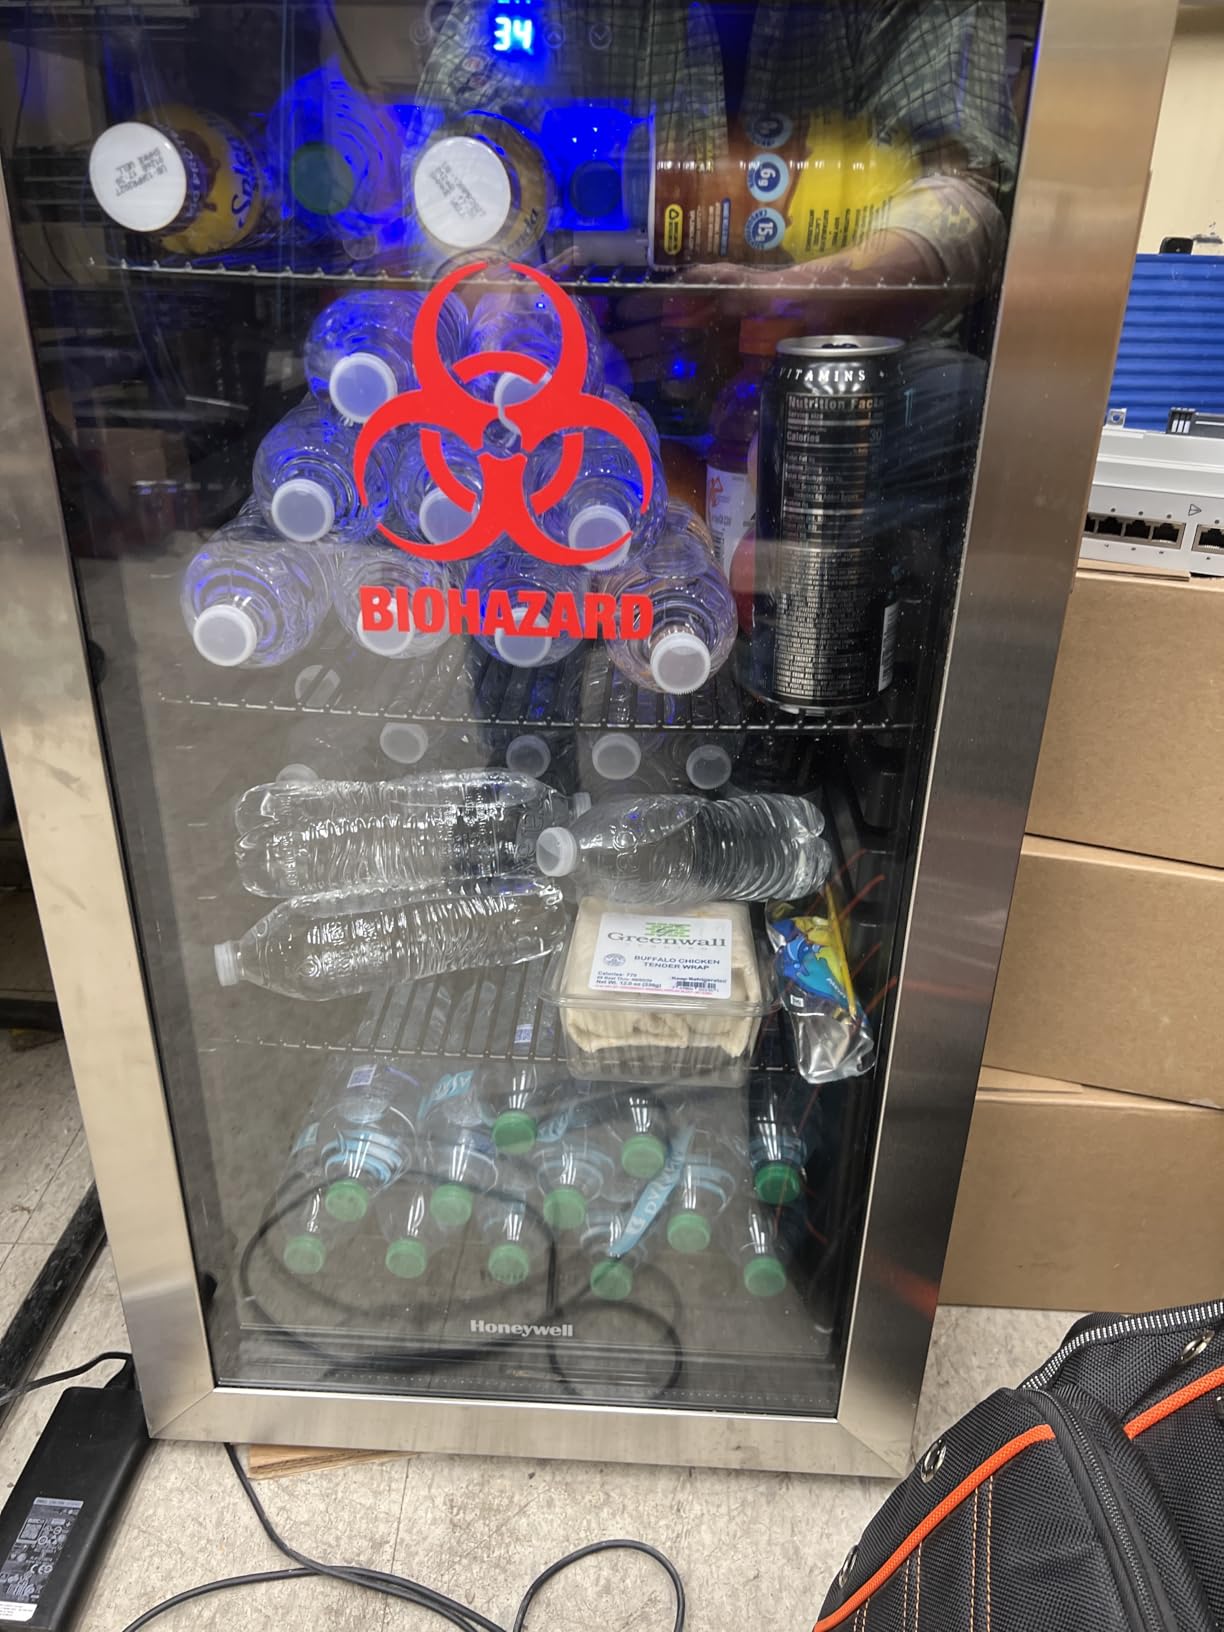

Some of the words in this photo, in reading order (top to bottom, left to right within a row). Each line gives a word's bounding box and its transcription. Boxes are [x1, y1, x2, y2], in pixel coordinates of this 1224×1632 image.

[493, 16, 533, 51] 34
[758, 168, 776, 187] 6g
[755, 221, 774, 241] 15g
[779, 367, 866, 382] VITAMINS
[788, 395, 846, 409] Nutrition
[786, 431, 820, 441] Calories
[358, 585, 653, 640] BIOHAZARD
[607, 932, 727, 947] Greenwall
[634, 955, 677, 963] BUFFALO
[678, 957, 721, 965] CHICKEN
[682, 963, 710, 971] WRAP
[470, 1319, 573, 1337] Honeywell
